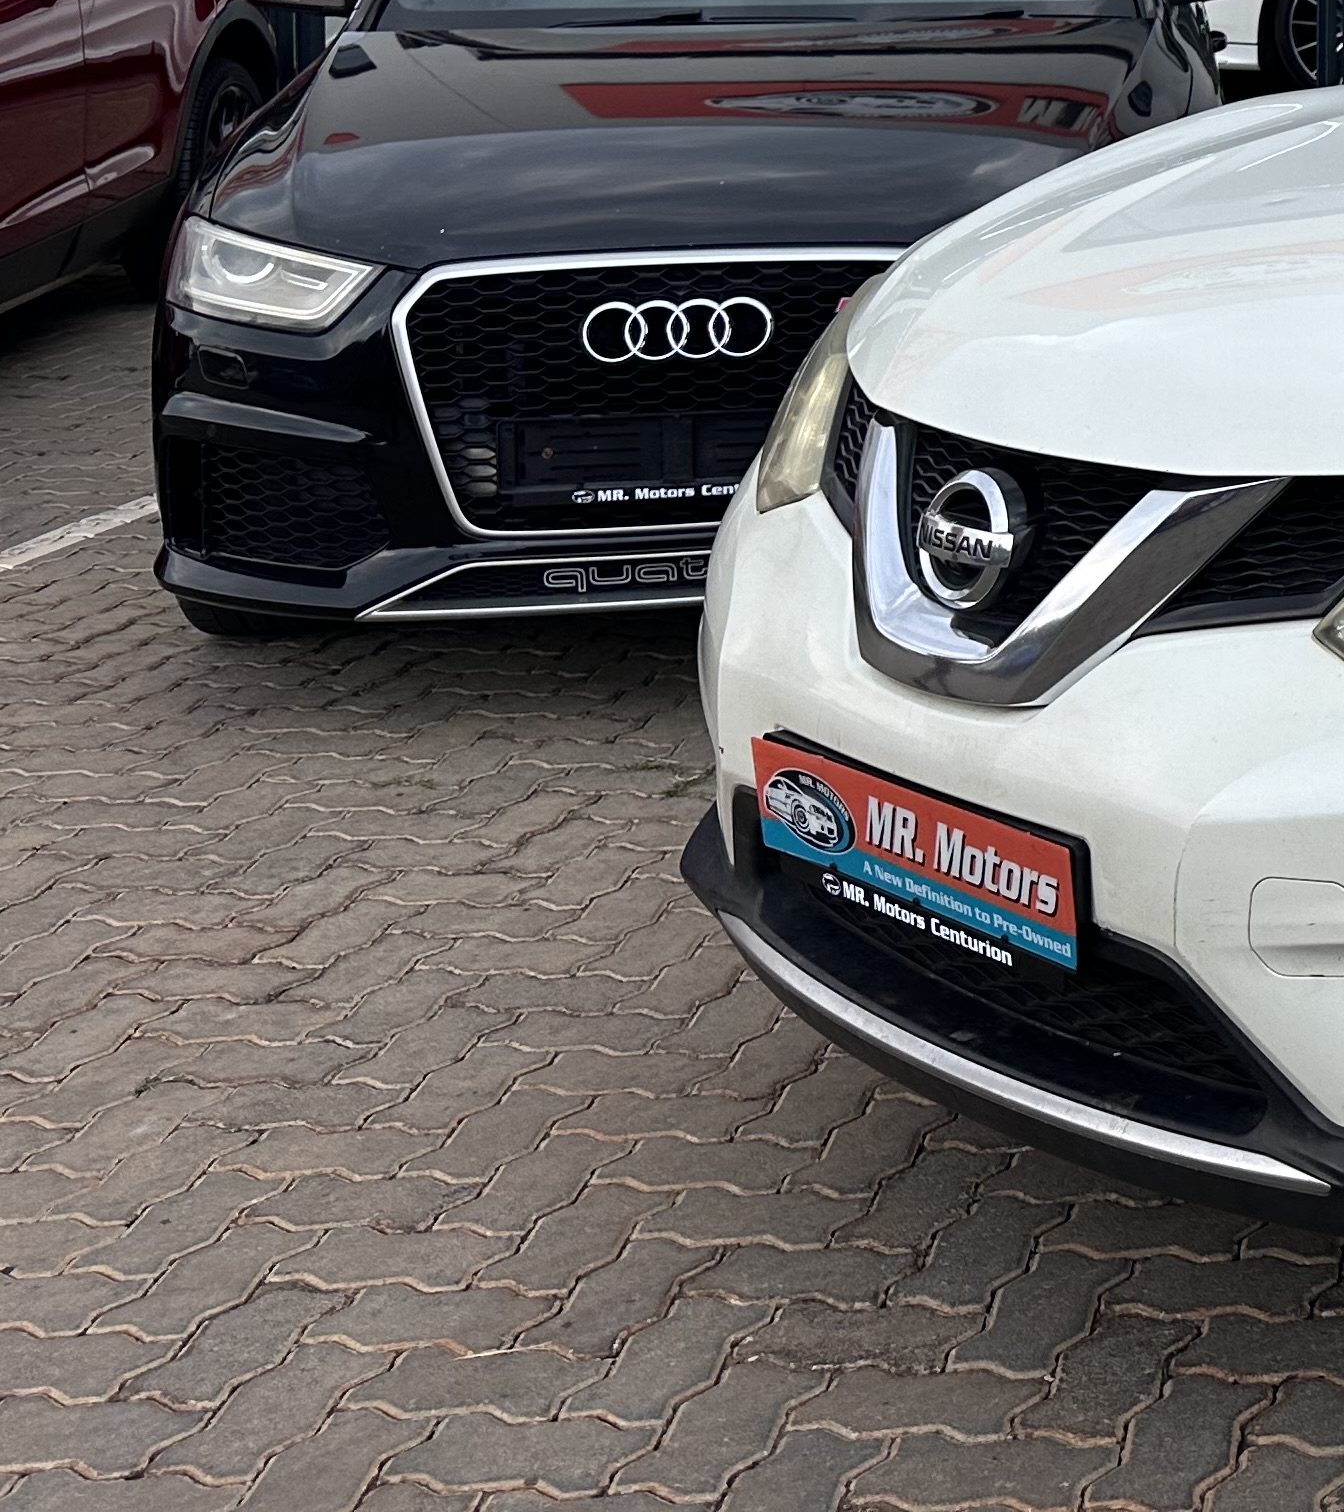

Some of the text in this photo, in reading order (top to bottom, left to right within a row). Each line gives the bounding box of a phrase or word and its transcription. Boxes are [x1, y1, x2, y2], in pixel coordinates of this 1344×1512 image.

[597, 489, 629, 502] MR.
[634, 487, 696, 500] Motors
[920, 523, 994, 559] NISSAN
[815, 780, 850, 822] MOTORS
[864, 794, 1059, 917] MR. Motors
[842, 881, 1013, 967] MR. Motors Centurion
[862, 860, 1072, 959] A New Definition to Pre-Owned
